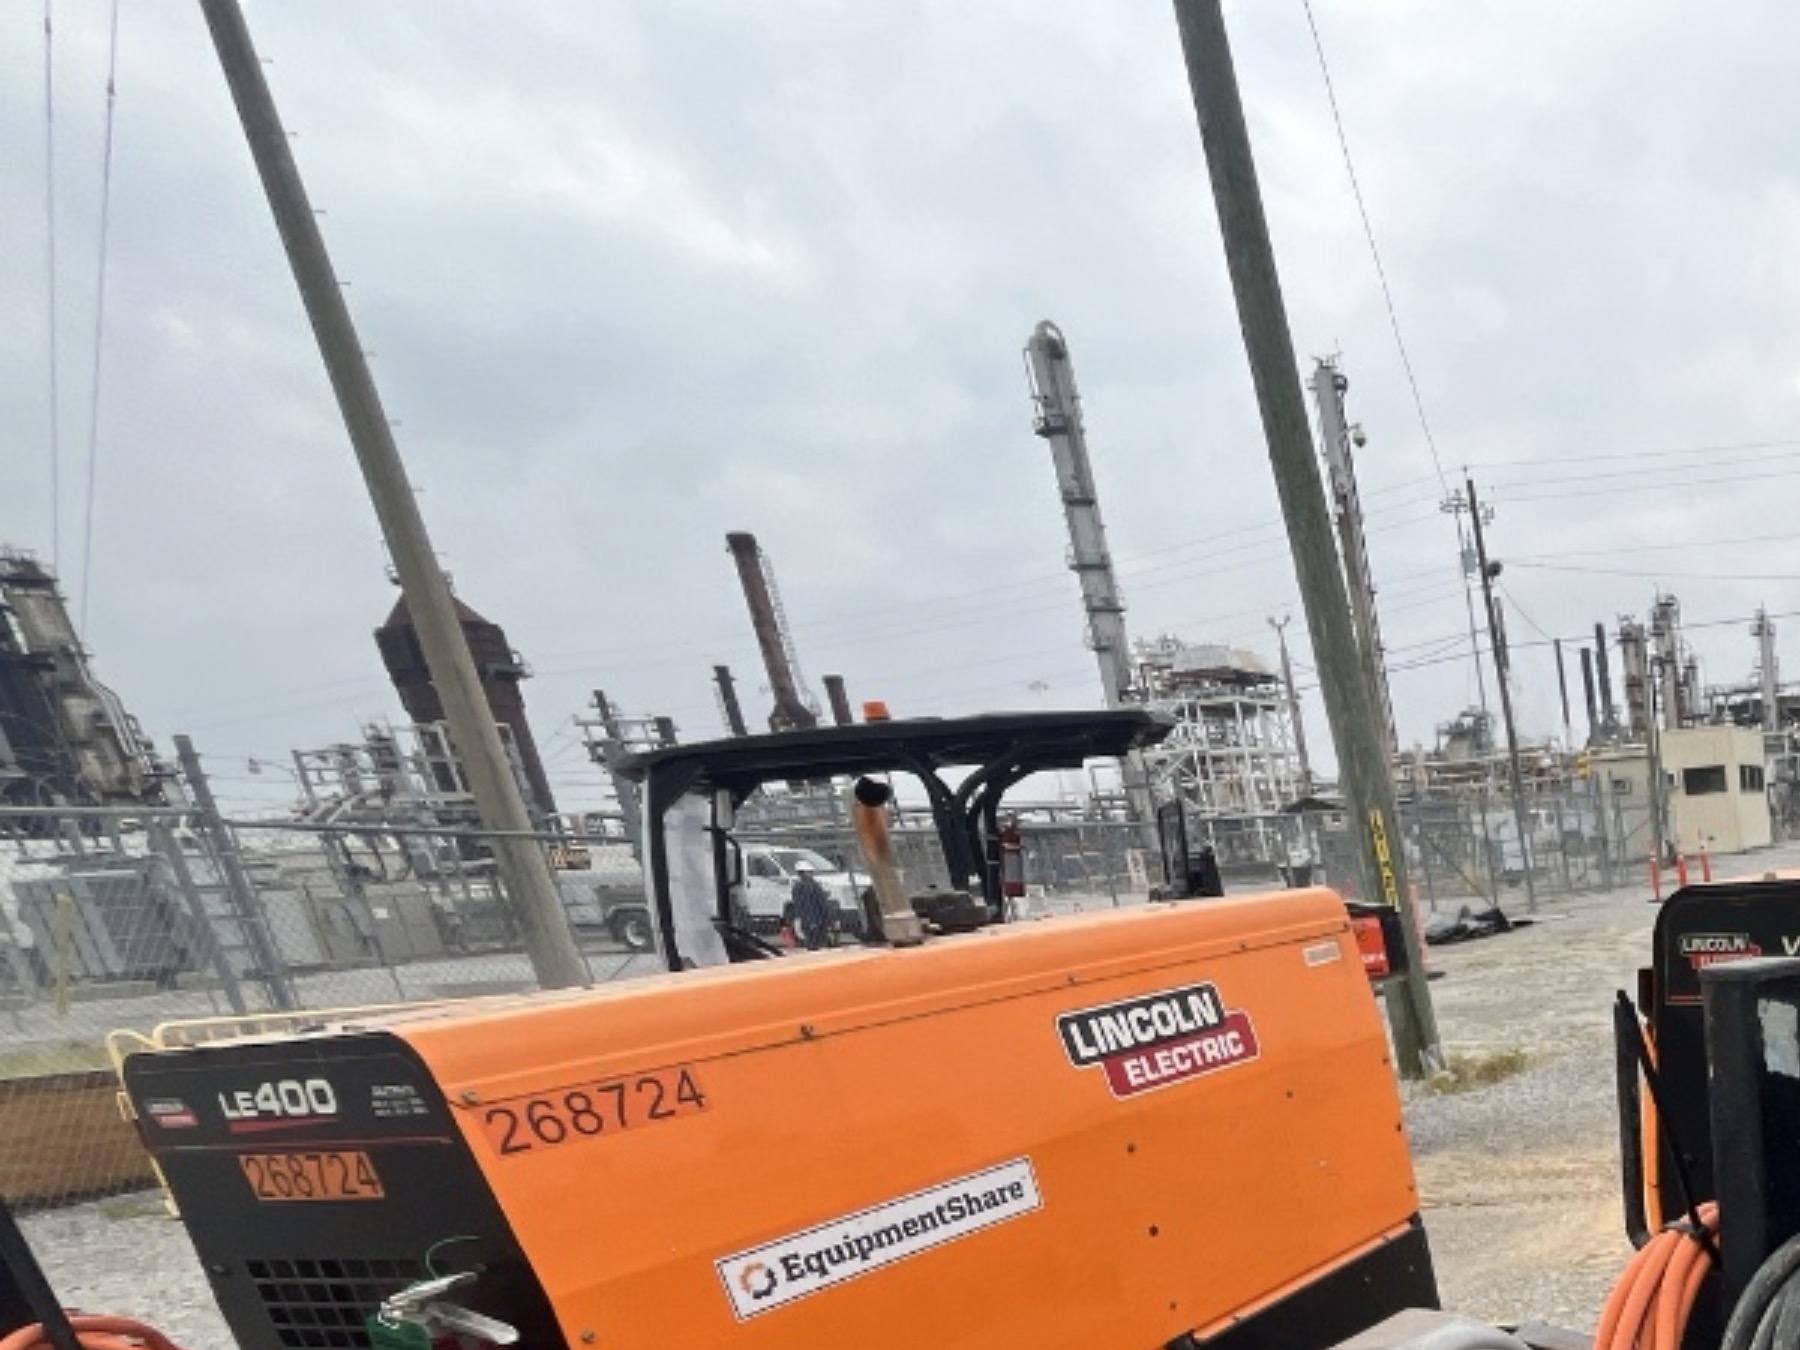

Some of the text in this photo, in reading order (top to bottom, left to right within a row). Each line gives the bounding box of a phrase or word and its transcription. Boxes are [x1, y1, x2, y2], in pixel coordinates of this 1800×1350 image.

[1068, 991, 1220, 1059] LINCOLN
[1122, 1030, 1246, 1088] ELECTRIC
[219, 1079, 338, 1120] LE400
[486, 1067, 707, 1156] 268724
[245, 1154, 380, 1198] 268724
[779, 1175, 1026, 1284] EquipmentShare
